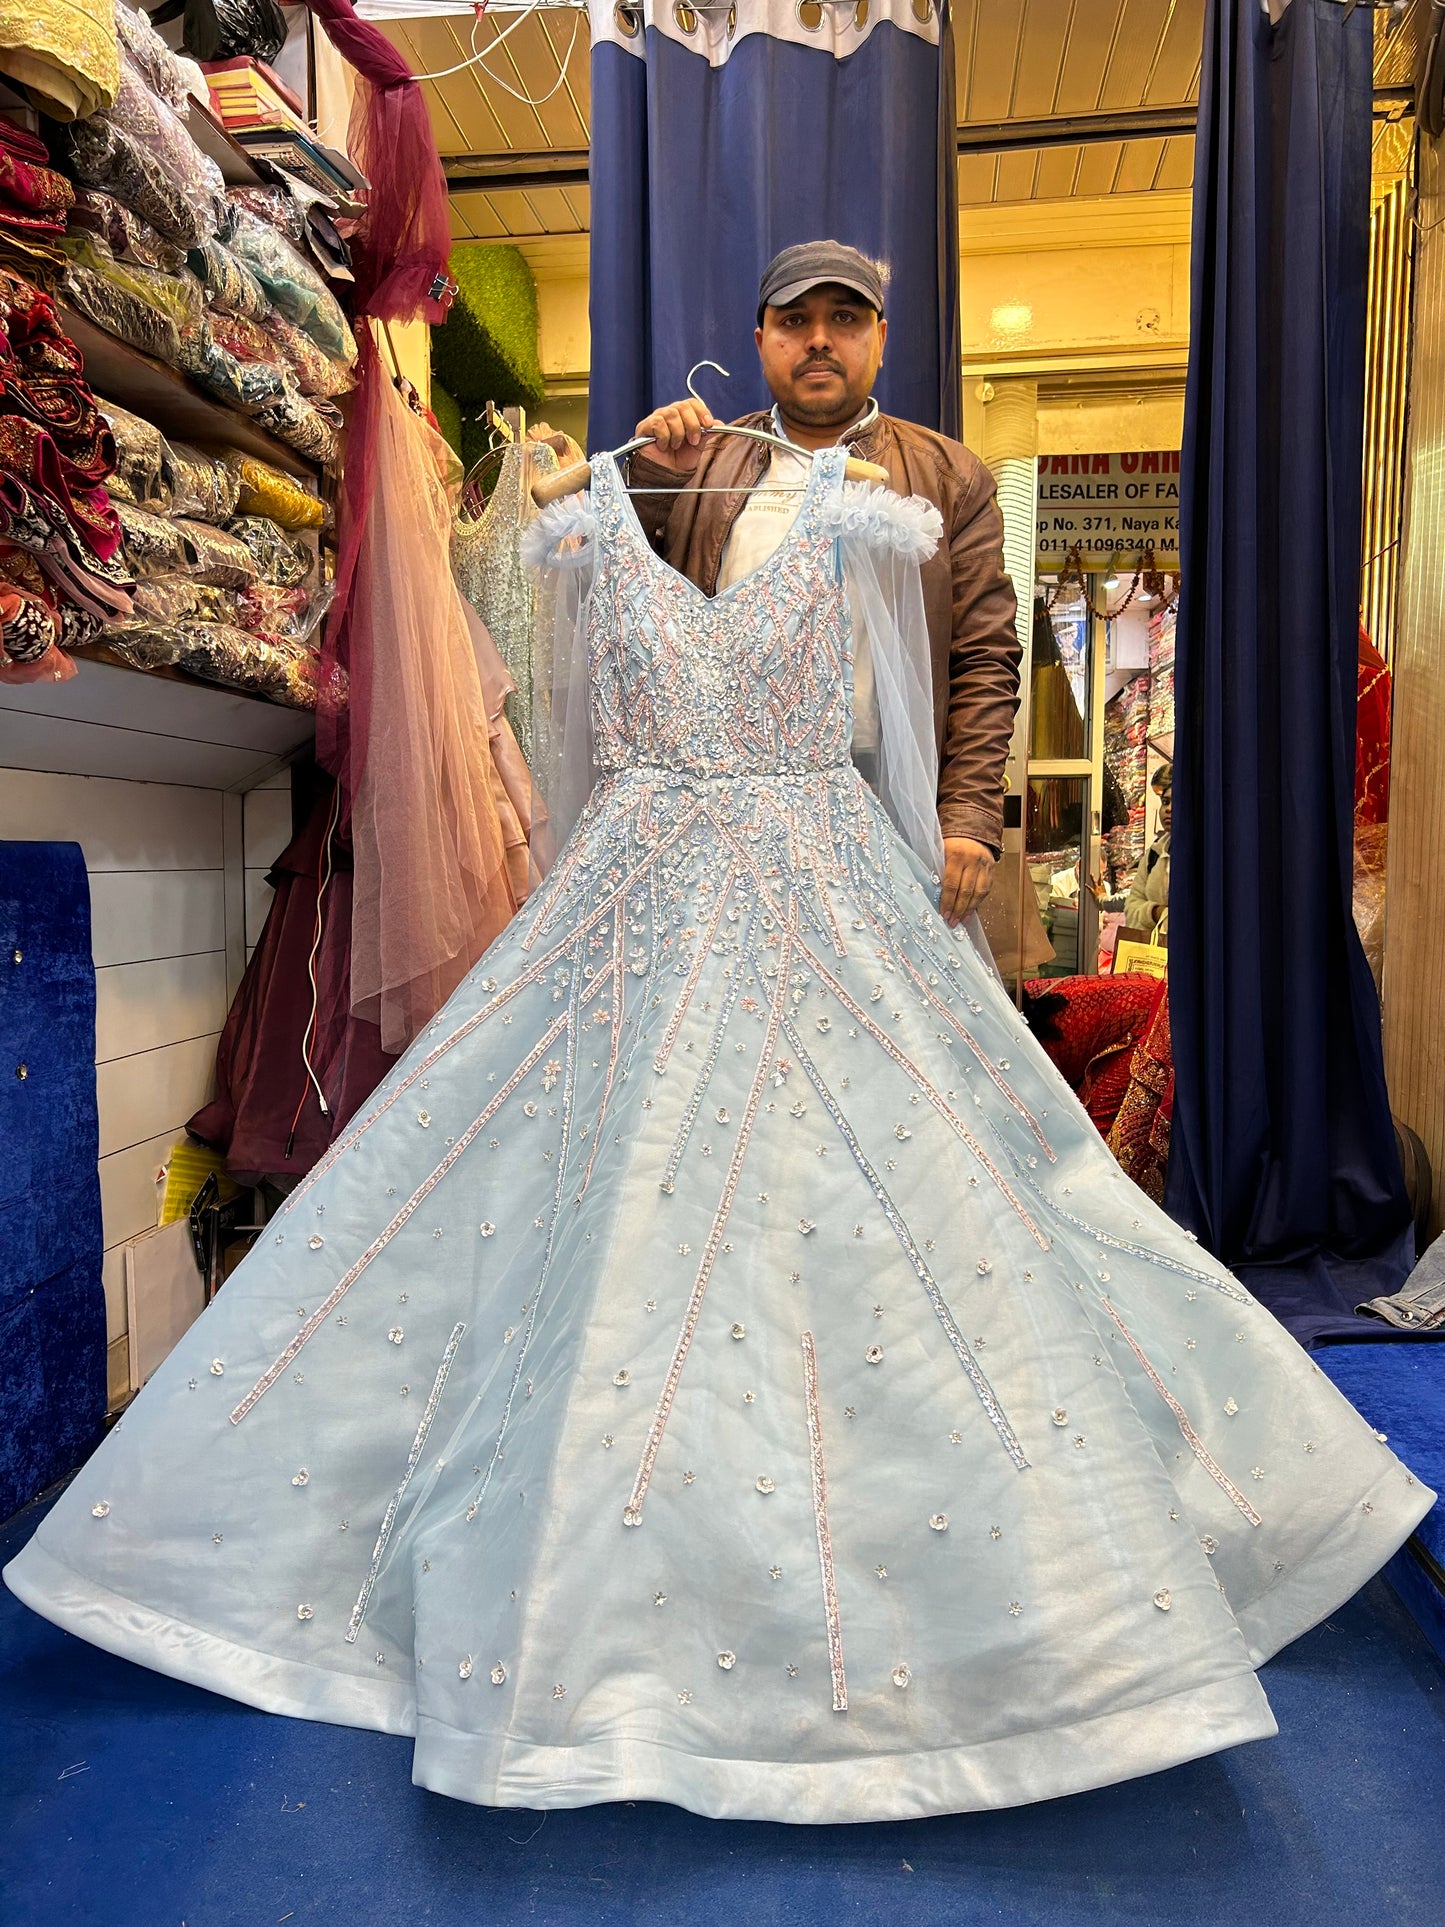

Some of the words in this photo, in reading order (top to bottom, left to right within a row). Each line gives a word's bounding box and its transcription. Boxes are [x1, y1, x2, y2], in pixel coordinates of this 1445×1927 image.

[1037, 483, 1118, 499] LESALER
[1125, 483, 1150, 499] OF
[1053, 517, 1077, 531] No.
[1082, 517, 1117, 532] 371,
[1122, 516, 1159, 533] Naya
